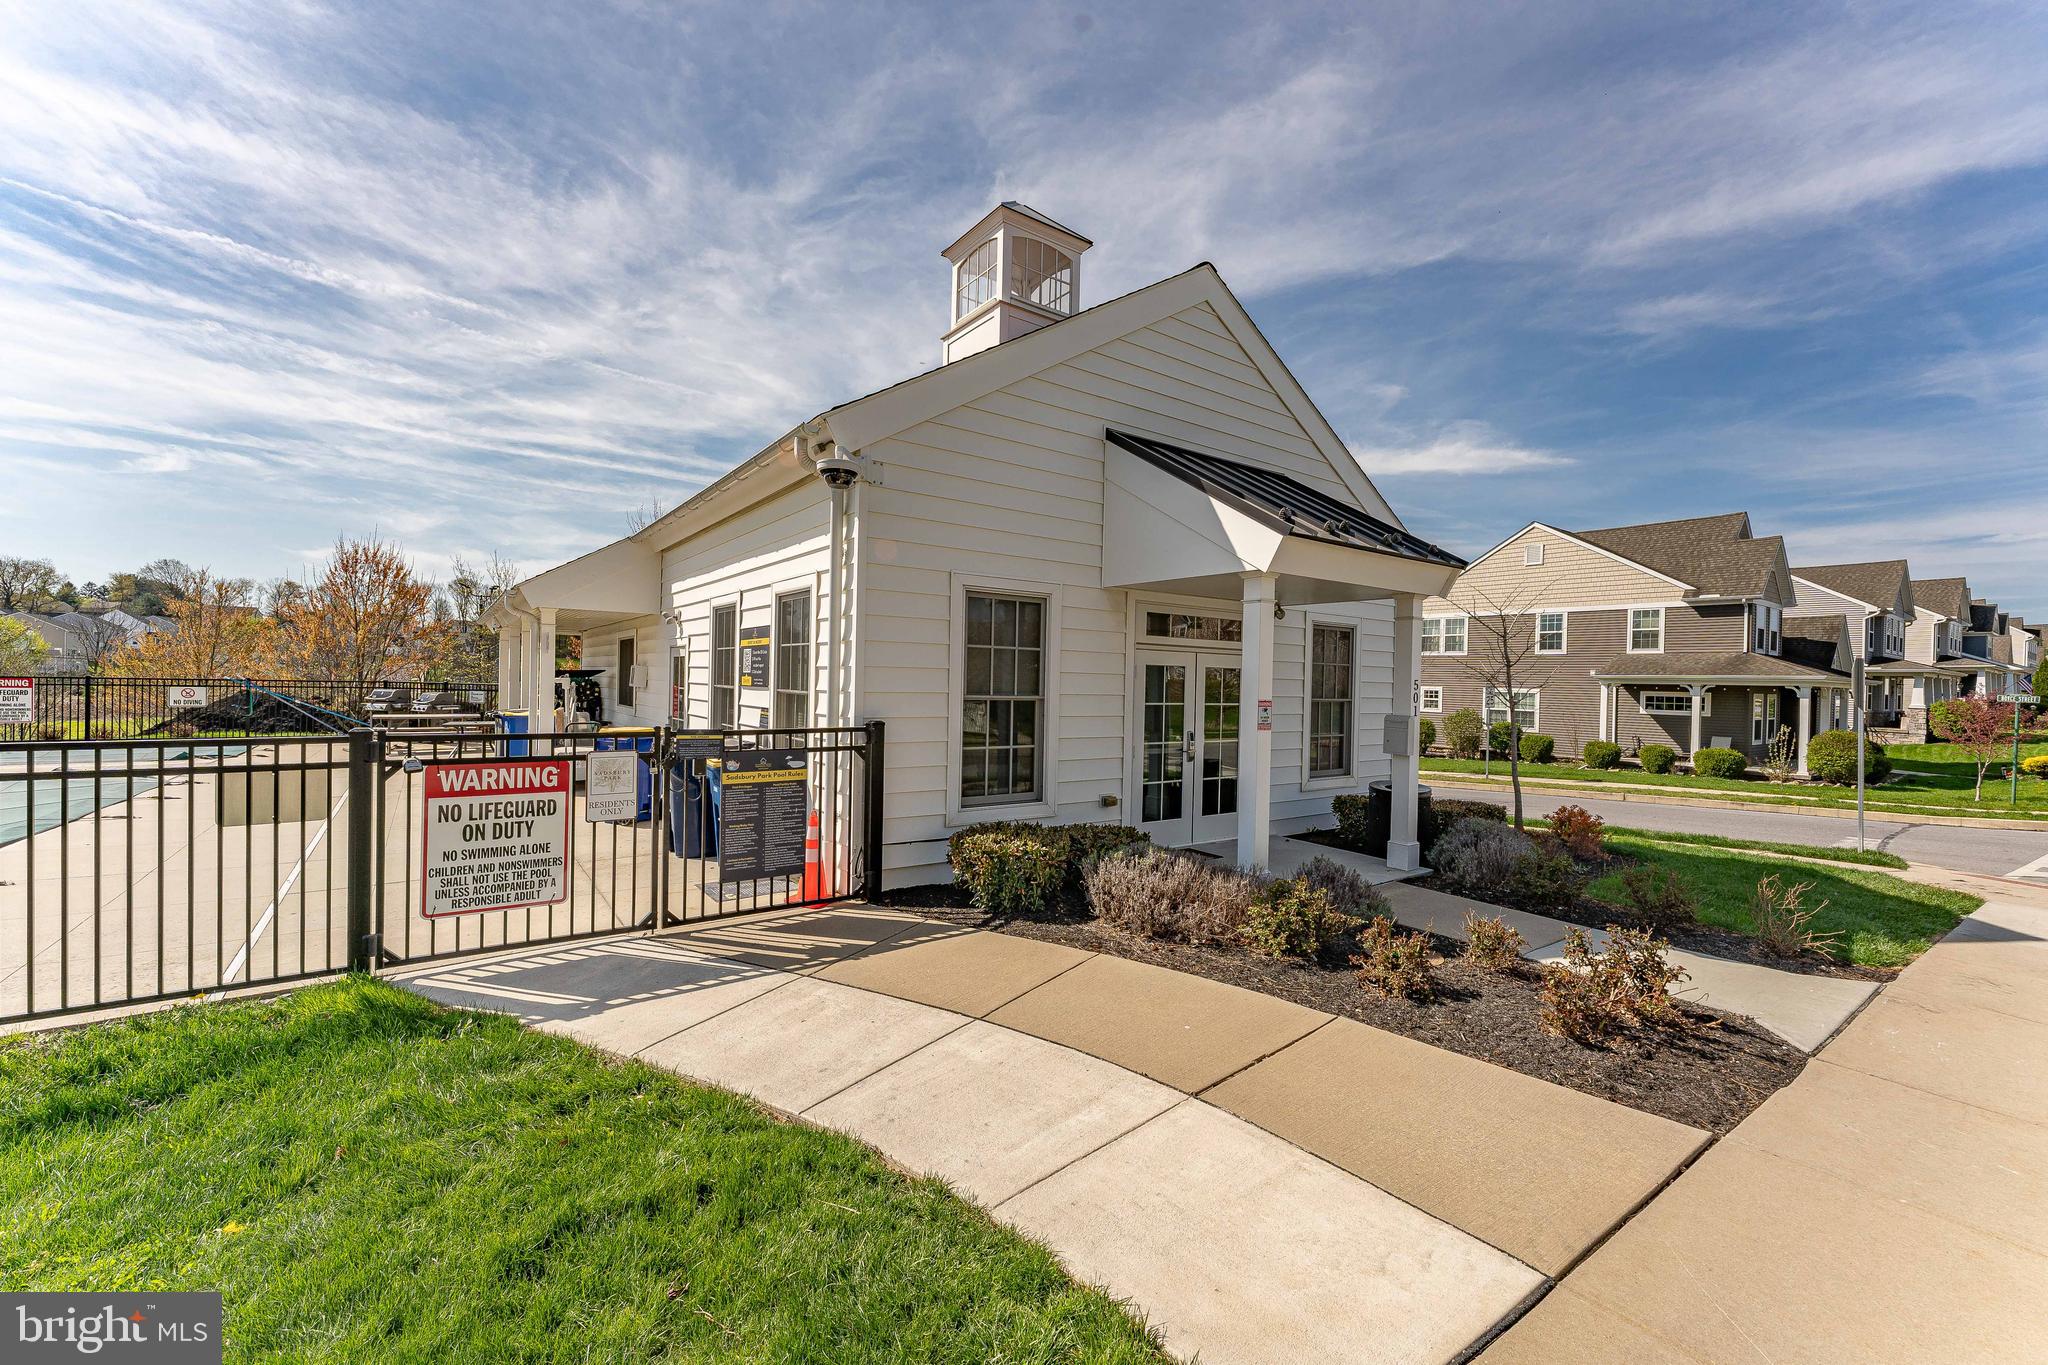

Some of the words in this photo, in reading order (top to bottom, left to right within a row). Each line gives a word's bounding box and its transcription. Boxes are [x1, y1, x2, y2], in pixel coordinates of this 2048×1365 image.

[0, 679, 29, 687] RNING
[439, 766, 558, 792] WARNING
[725, 773, 756, 781] Sadsbury
[438, 804, 462, 823] NO
[468, 799, 557, 821] LIFEGUARD
[589, 799, 635, 809] RESIDENTS
[600, 807, 624, 816] ONLY
[462, 823, 486, 842] ON
[492, 820, 534, 840] DUTY
[442, 850, 458, 862] NO
[461, 845, 517, 861] SWIMMING
[519, 842, 551, 856] ALONE
[428, 864, 474, 878] CHILDREN
[477, 863, 496, 874] AND
[498, 856, 563, 871] NONSWIMMERS
[434, 886, 470, 900] UNLESS
[472, 879, 535, 896] ACCOMPANIED
[538, 878, 549, 889] BY
[550, 877, 557, 888] A
[440, 876, 469, 889] SHALL
[472, 874, 491, 885] NOT
[493, 872, 509, 883] USE
[512, 870, 528, 881] THE
[530, 868, 552, 880] POOL
[451, 892, 512, 910] RESPONSIBLE
[514, 889, 541, 902] ADULT
